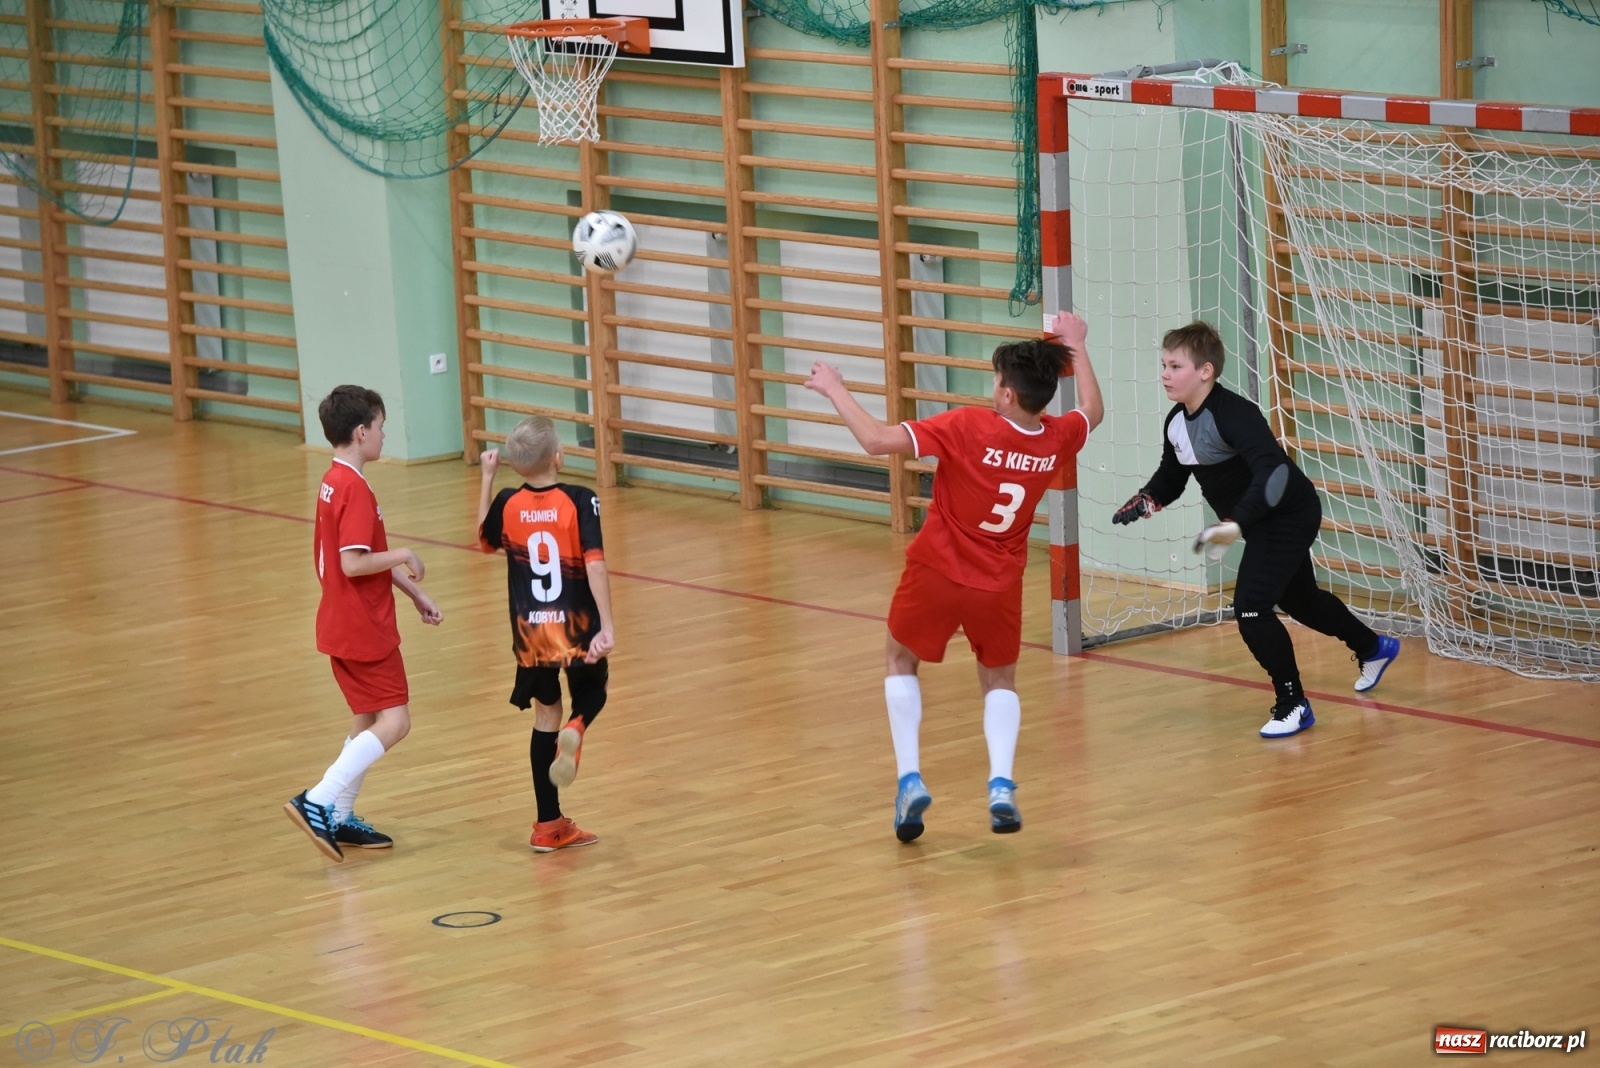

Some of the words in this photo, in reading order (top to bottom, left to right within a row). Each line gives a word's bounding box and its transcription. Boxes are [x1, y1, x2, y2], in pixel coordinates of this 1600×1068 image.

[1095, 84, 1120, 96] sport
[982, 447, 1004, 467] ZS
[1005, 452, 1057, 472] KIETRZ
[520, 507, 558, 523] PŁOMIEŃ
[978, 482, 1026, 534] 3
[527, 530, 563, 603] 9
